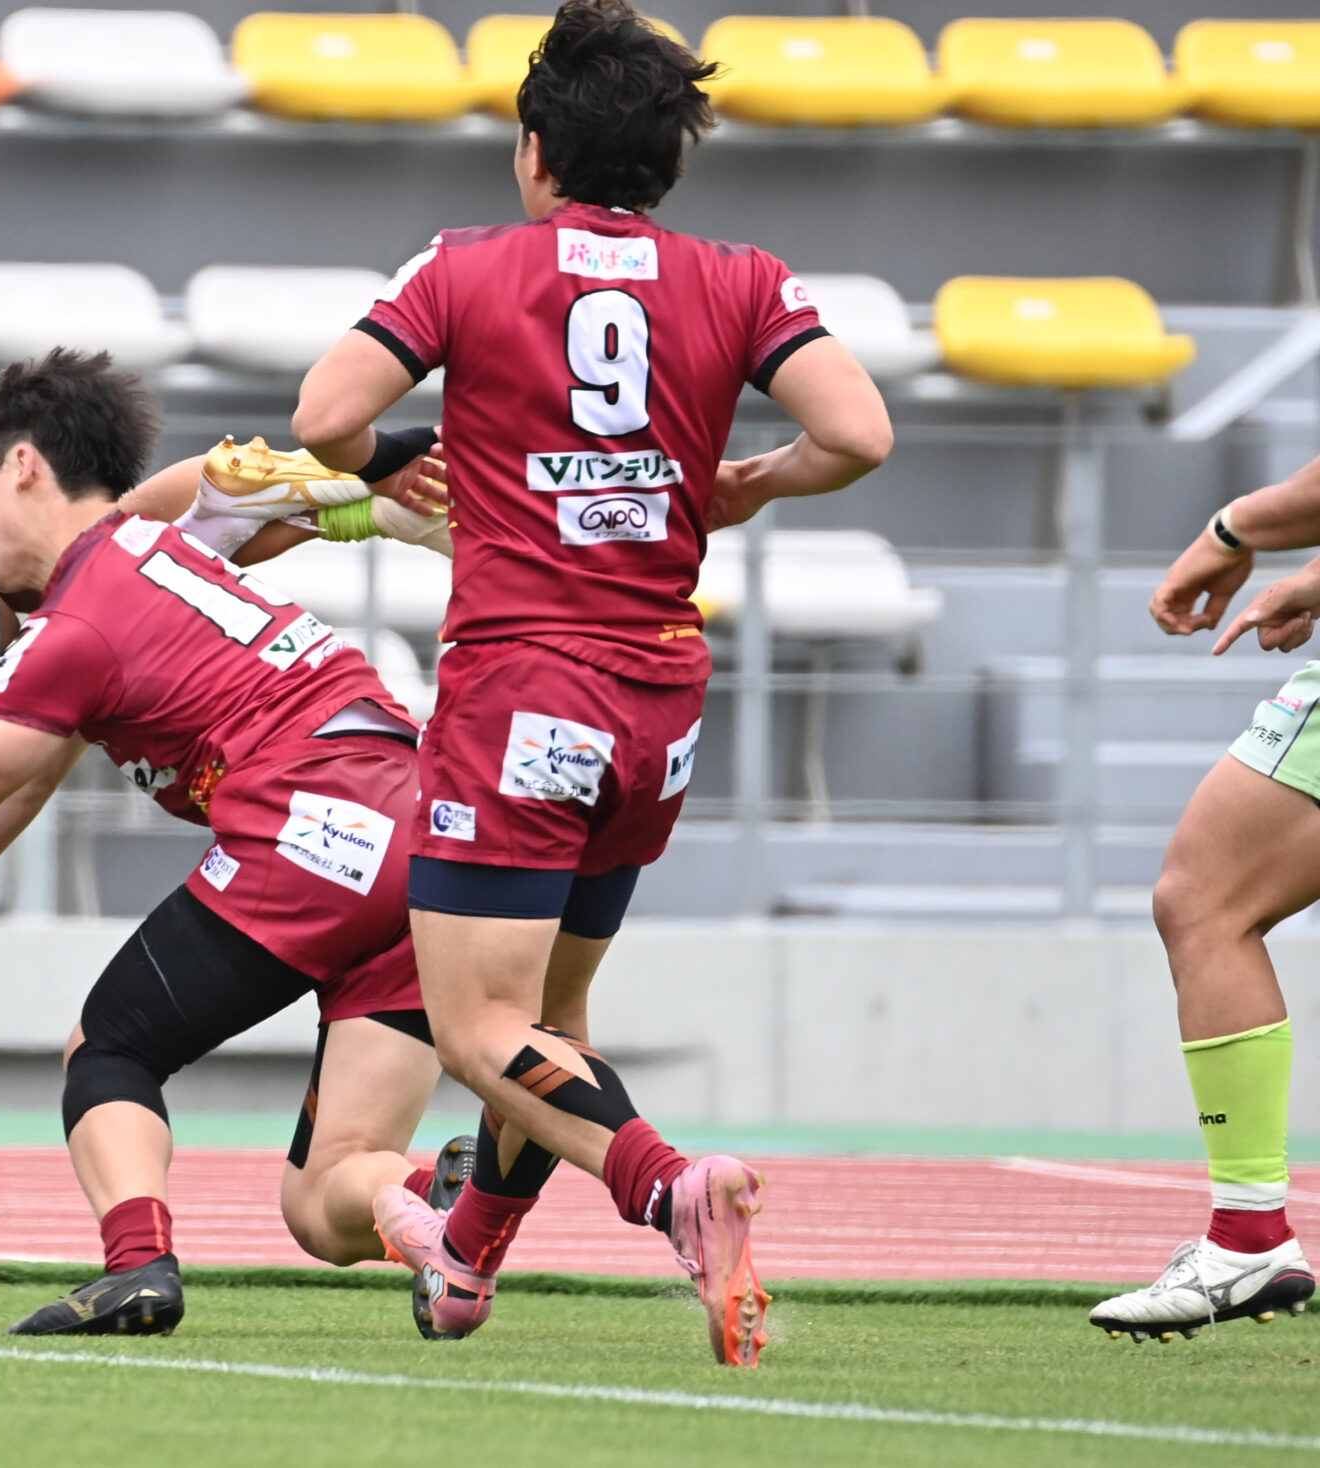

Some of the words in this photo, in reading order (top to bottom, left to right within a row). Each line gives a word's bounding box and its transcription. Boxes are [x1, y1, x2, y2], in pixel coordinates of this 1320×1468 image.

[564, 287, 651, 438] 9
[546, 746, 601, 768] Kyuken
[321, 820, 376, 853] Kyuken
